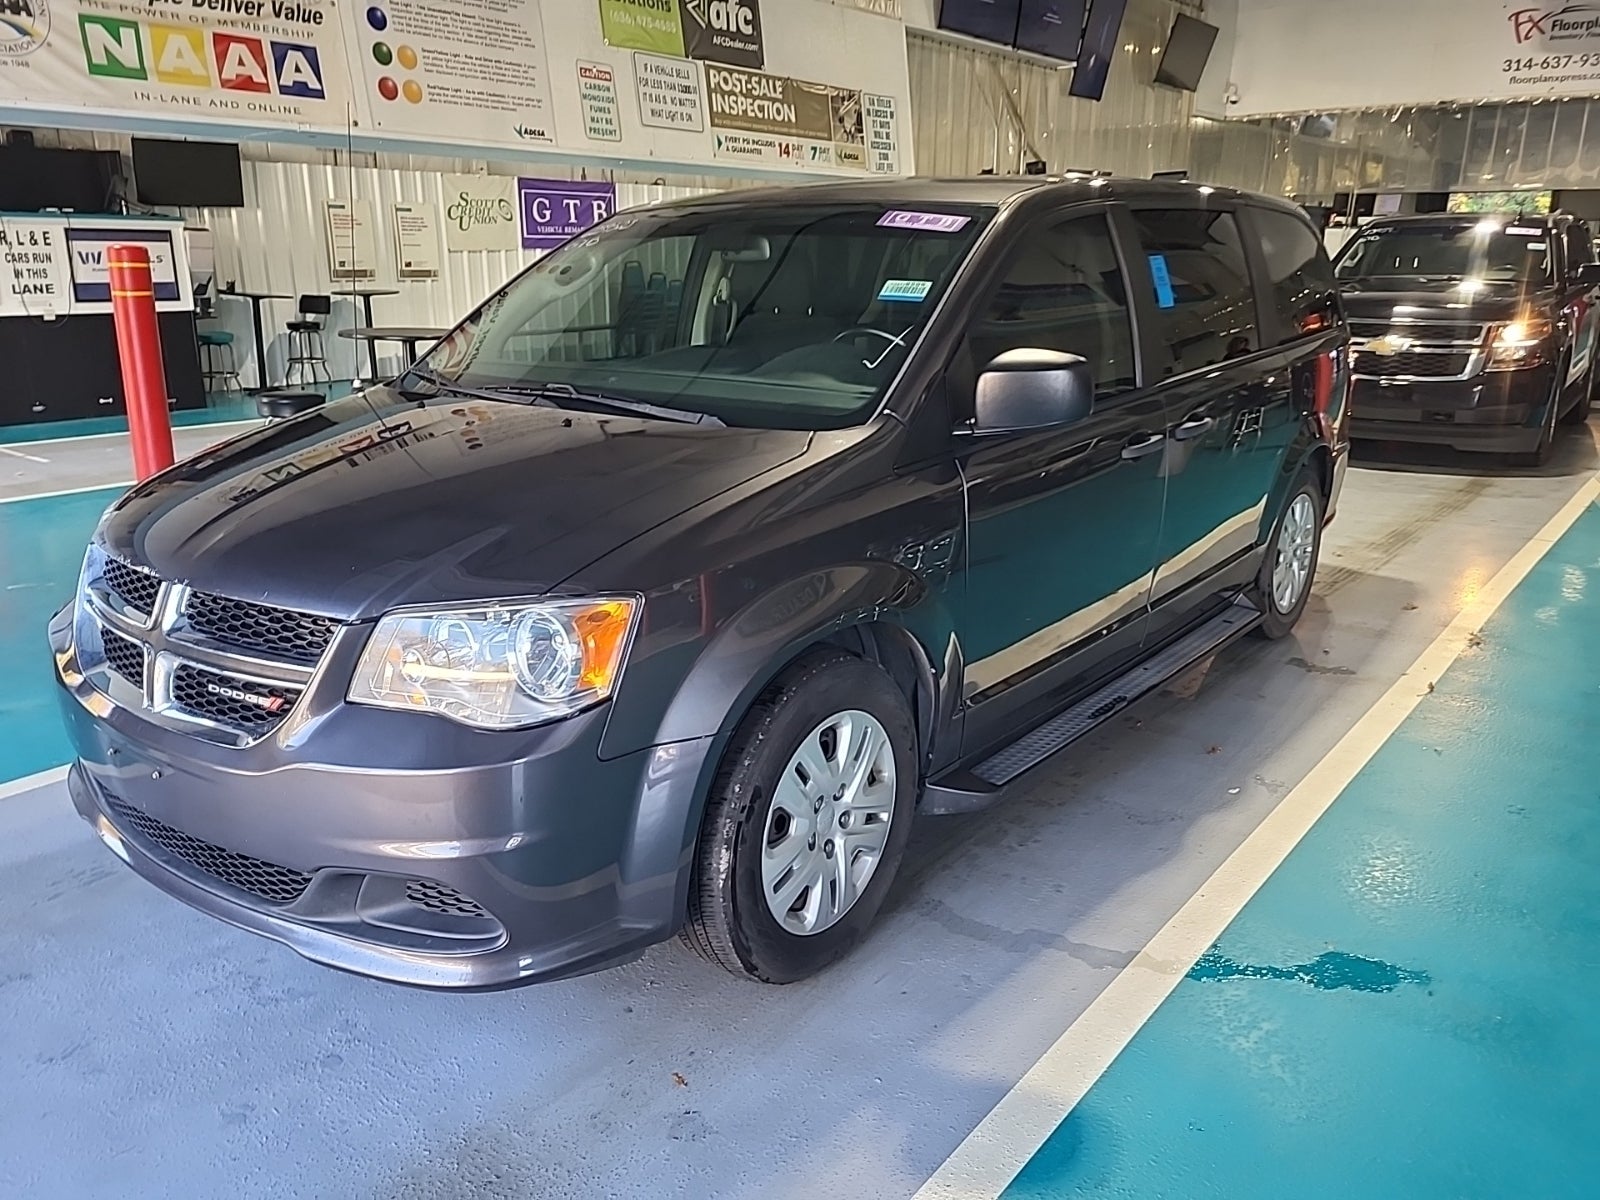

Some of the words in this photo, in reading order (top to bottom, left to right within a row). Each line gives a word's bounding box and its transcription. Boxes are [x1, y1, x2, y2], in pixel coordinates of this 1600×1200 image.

[271, 0, 324, 25] Value
[709, 0, 753, 35] afc
[120, 4, 180, 20] POWER
[189, 15, 208, 24] OF
[217, 19, 314, 39] MEMBERSHIP
[1551, 16, 1600, 32] Floorpl
[0, 39, 37, 54] IATION
[713, 35, 759, 52] AFCDealer.com
[1502, 53, 1600, 72] 314-637-93
[581, 68, 611, 80] CAUTION
[584, 82, 611, 92] CARBON
[639, 76, 649, 87] FOR
[650, 78, 663, 90] LESS
[663, 80, 677, 92] THAN
[709, 69, 783, 99] POST-SALE
[134, 91, 202, 106] IN-LANE
[209, 99, 240, 110] AND
[247, 102, 303, 115] ONLINE
[582, 93, 615, 104] MONOXIDE
[590, 105, 611, 114] FUMES
[711, 93, 797, 124] INSPECTION
[590, 116, 604, 125] MAY
[605, 117, 613, 126] BE
[524, 127, 546, 137] ADESA
[589, 126, 617, 137] PRESENT
[731, 146, 762, 155] GUARANTEE
[778, 142, 790, 158] 14
[792, 143, 803, 152] DAY
[810, 146, 818, 160] 7
[15, 229, 24, 245] L
[28, 230, 38, 246] &
[42, 231, 51, 246] E
[537, 226, 562, 234] VEHICLE
[4, 252, 29, 263] CARS
[32, 252, 52, 264] RUN
[13, 267, 23, 279] IN
[25, 267, 48, 279] THIS
[11, 283, 55, 294] LANE
[208, 683, 270, 708] DODGE
